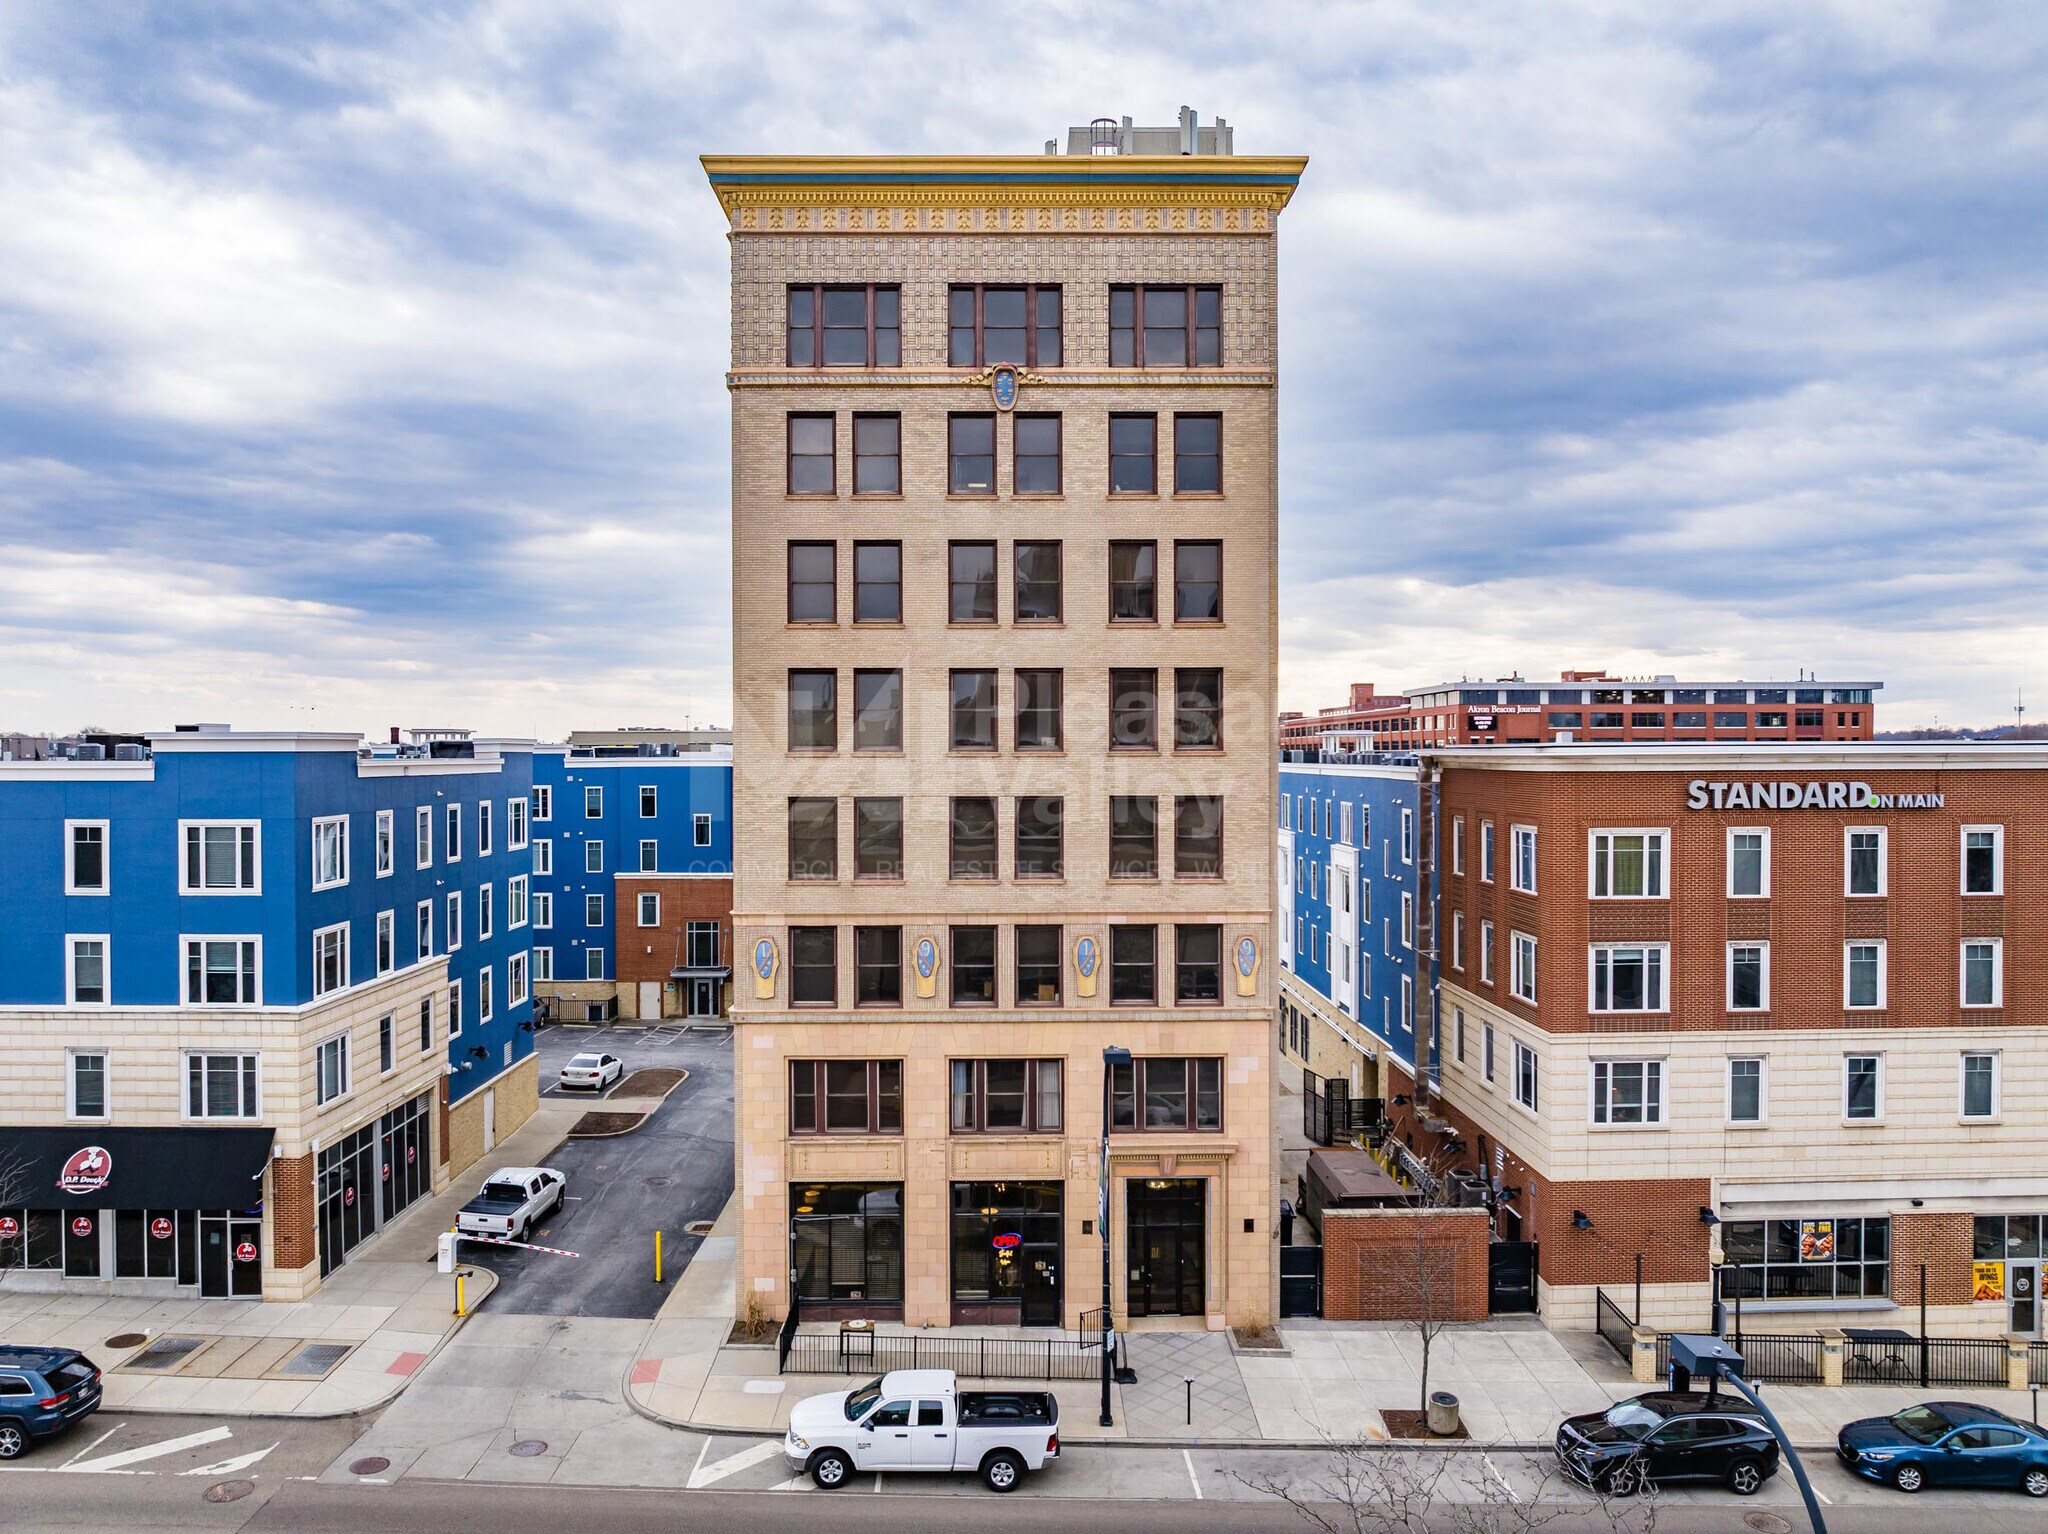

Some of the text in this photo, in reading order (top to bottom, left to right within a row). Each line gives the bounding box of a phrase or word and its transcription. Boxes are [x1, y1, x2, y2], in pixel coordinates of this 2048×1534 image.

[1468, 705, 1541, 713] Akron Beacon Journal
[1687, 780, 1945, 810] STANDARD ON MAIN
[993, 1235, 1019, 1247] OPEN
